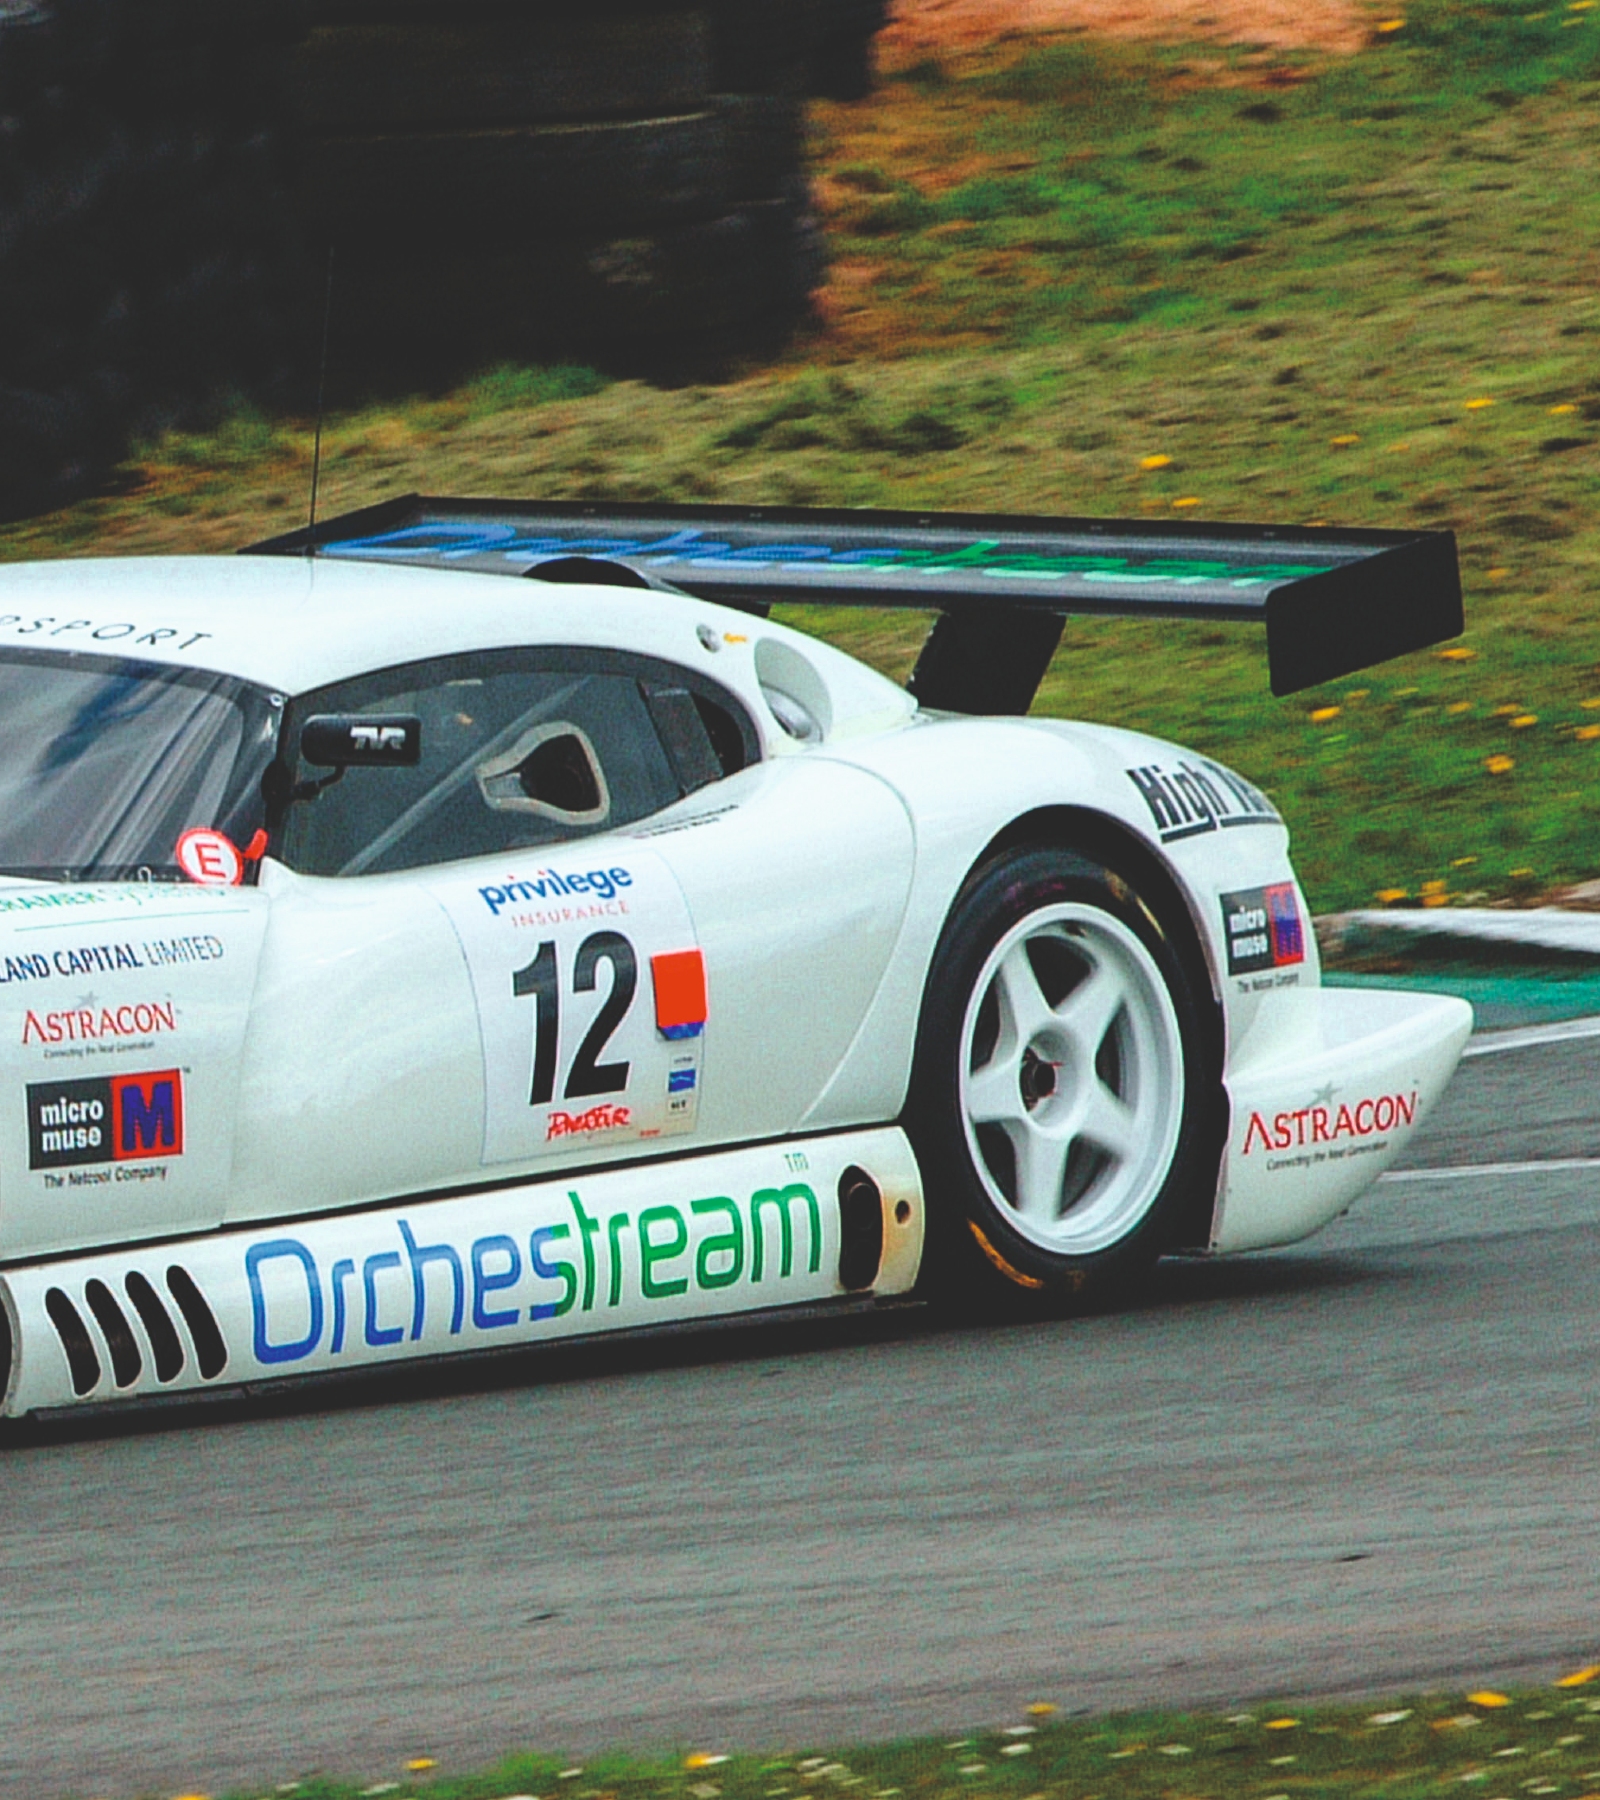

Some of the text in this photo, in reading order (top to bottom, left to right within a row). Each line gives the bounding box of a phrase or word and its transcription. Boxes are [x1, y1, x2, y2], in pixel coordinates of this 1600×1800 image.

[350, 726, 406, 750] TVR
[195, 842, 227, 879] E
[479, 866, 633, 916] privilege
[511, 900, 631, 928] INSURANCE
[1229, 906, 1267, 934] micro
[53, 944, 144, 977] CAPITAL
[146, 935, 225, 966] LIMITED
[21, 1001, 178, 1044] ASTRACON
[512, 930, 639, 1107] 12
[40, 1096, 104, 1127] micro
[120, 1081, 176, 1151] M
[1242, 1091, 1417, 1156] ASTRACON
[41, 1125, 103, 1153] muse
[43, 1164, 168, 1189] The Netcool Company
[246, 1183, 821, 1364] Orchestream
